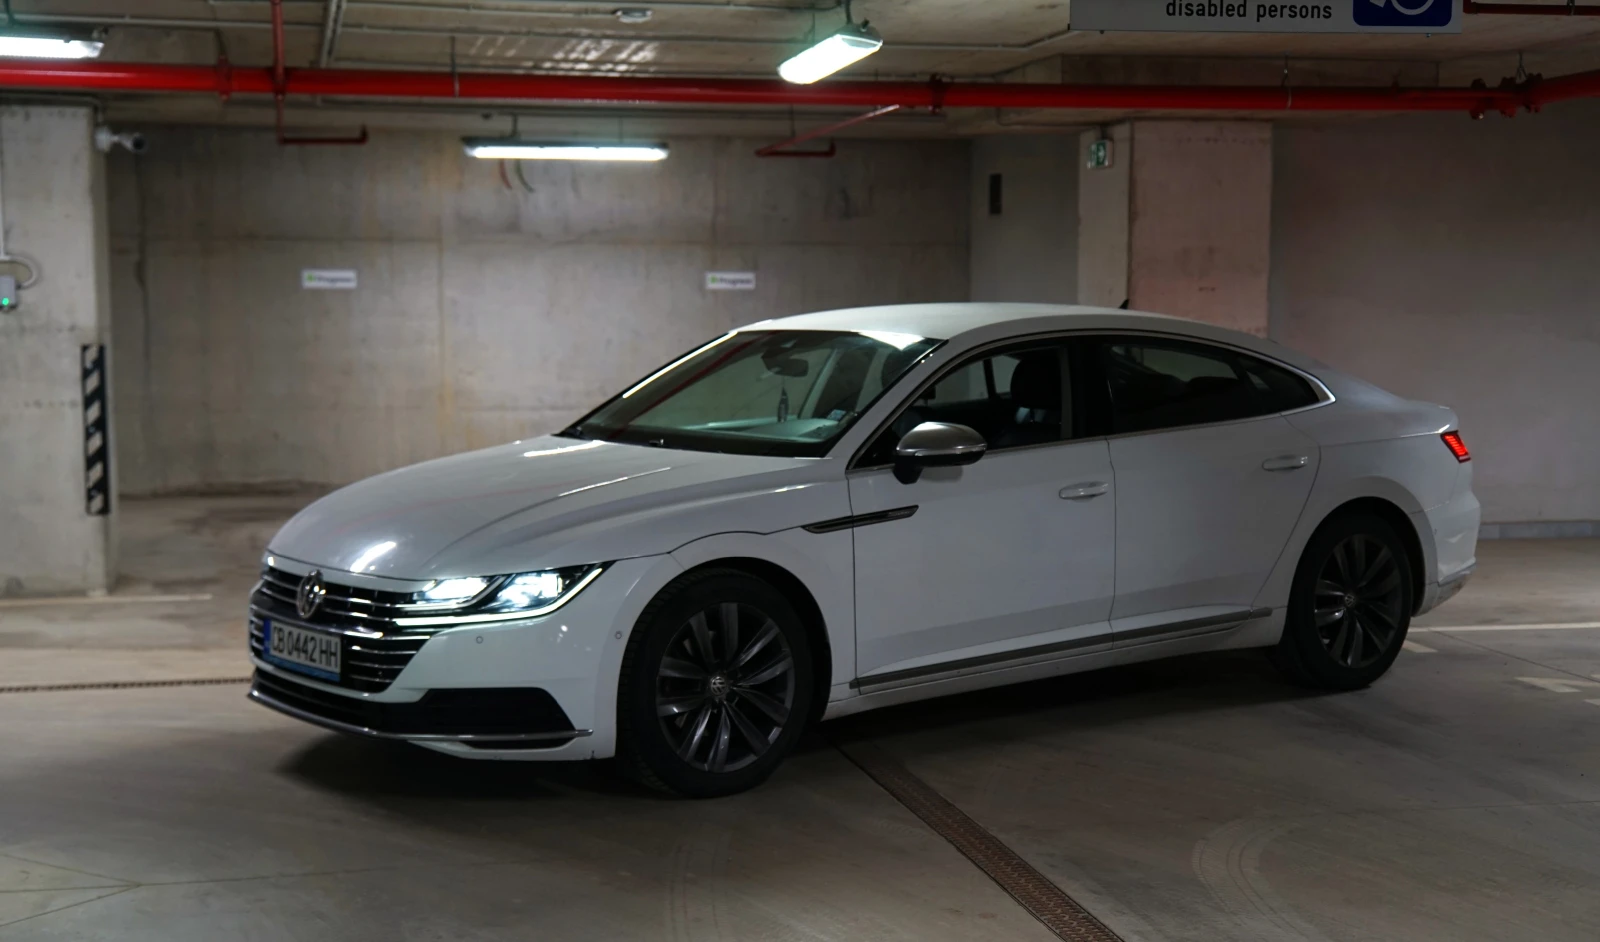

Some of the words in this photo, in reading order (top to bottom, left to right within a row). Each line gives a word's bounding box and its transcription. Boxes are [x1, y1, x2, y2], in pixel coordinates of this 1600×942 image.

[1166, 0, 1247, 18] disabled
[1256, 3, 1332, 22] persons
[287, 630, 317, 663] 0442
[319, 639, 338, 668] HH
